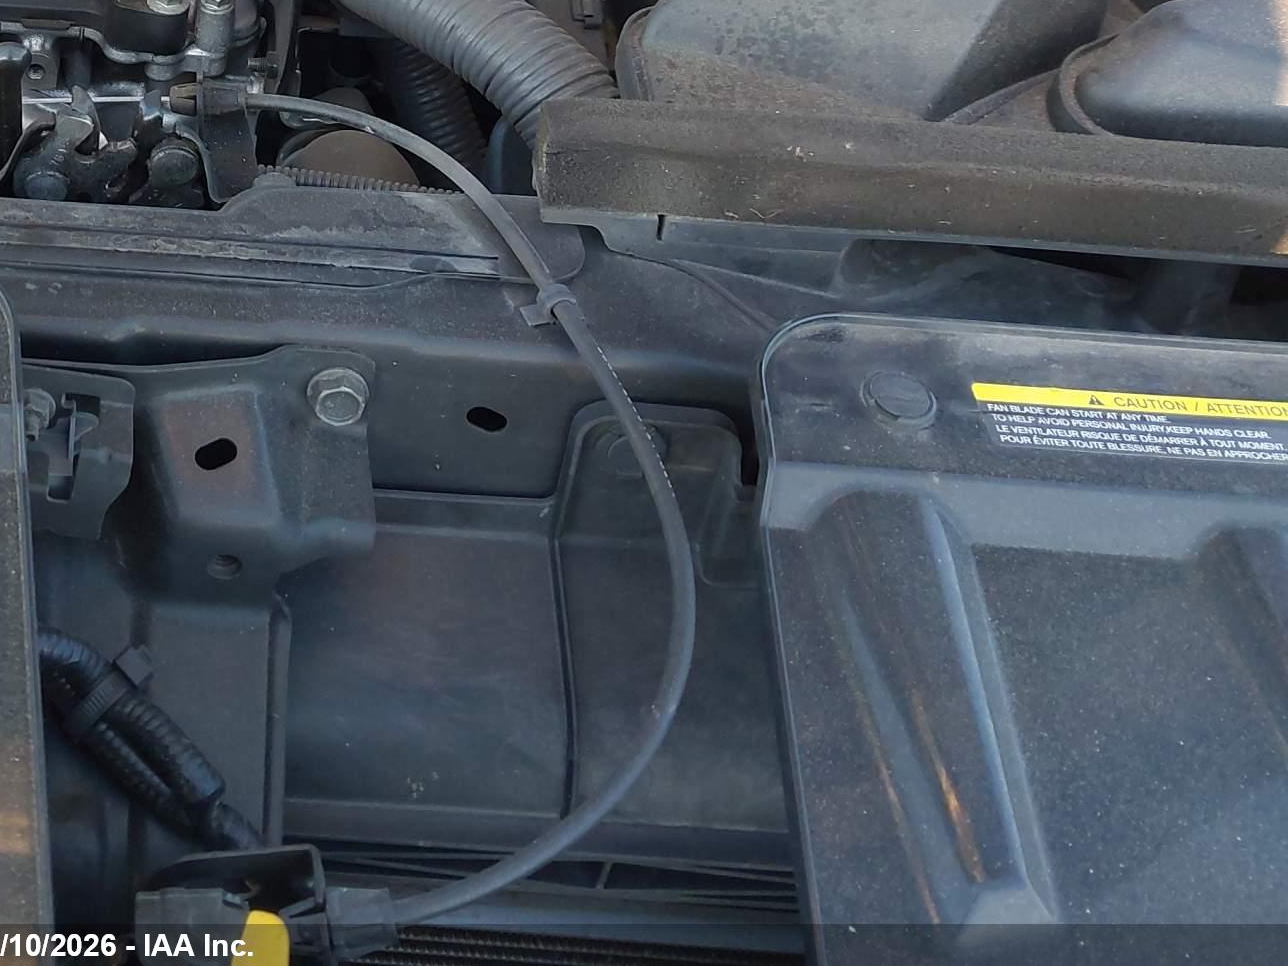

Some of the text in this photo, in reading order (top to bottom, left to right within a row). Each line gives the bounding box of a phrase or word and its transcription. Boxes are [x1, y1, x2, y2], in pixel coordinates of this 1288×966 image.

[987, 403, 1009, 412] FAN
[1010, 405, 1045, 414] BLADE
[1046, 407, 1070, 416] CAN
[1071, 409, 1103, 419] START
[1106, 411, 1118, 420] AT
[1121, 413, 1142, 421] ANY
[1113, 396, 1188, 411] CAUTION
[992, 413, 1007, 422] TO
[1008, 415, 1035, 423] HELP
[1038, 417, 1070, 426] AVOID
[1072, 419, 1129, 430] PERSONAL
[1194, 427, 1233, 437] HANDS
[995, 425, 1011, 433] LE
[1010, 426, 1079, 438] VENTILATEUR
[1081, 431, 1122, 441] RISQUE
[1122, 433, 1139, 442] DE
[1209, 439, 1236, 448] TOUT
[999, 434, 1033, 444] POUR
[1032, 434, 1070, 446] ÉVITER
[1070, 439, 1107, 449] TOUTE
[1166, 446, 1184, 454] NE
[1183, 447, 1206, 456] PAS
[1206, 449, 1222, 457] EN
